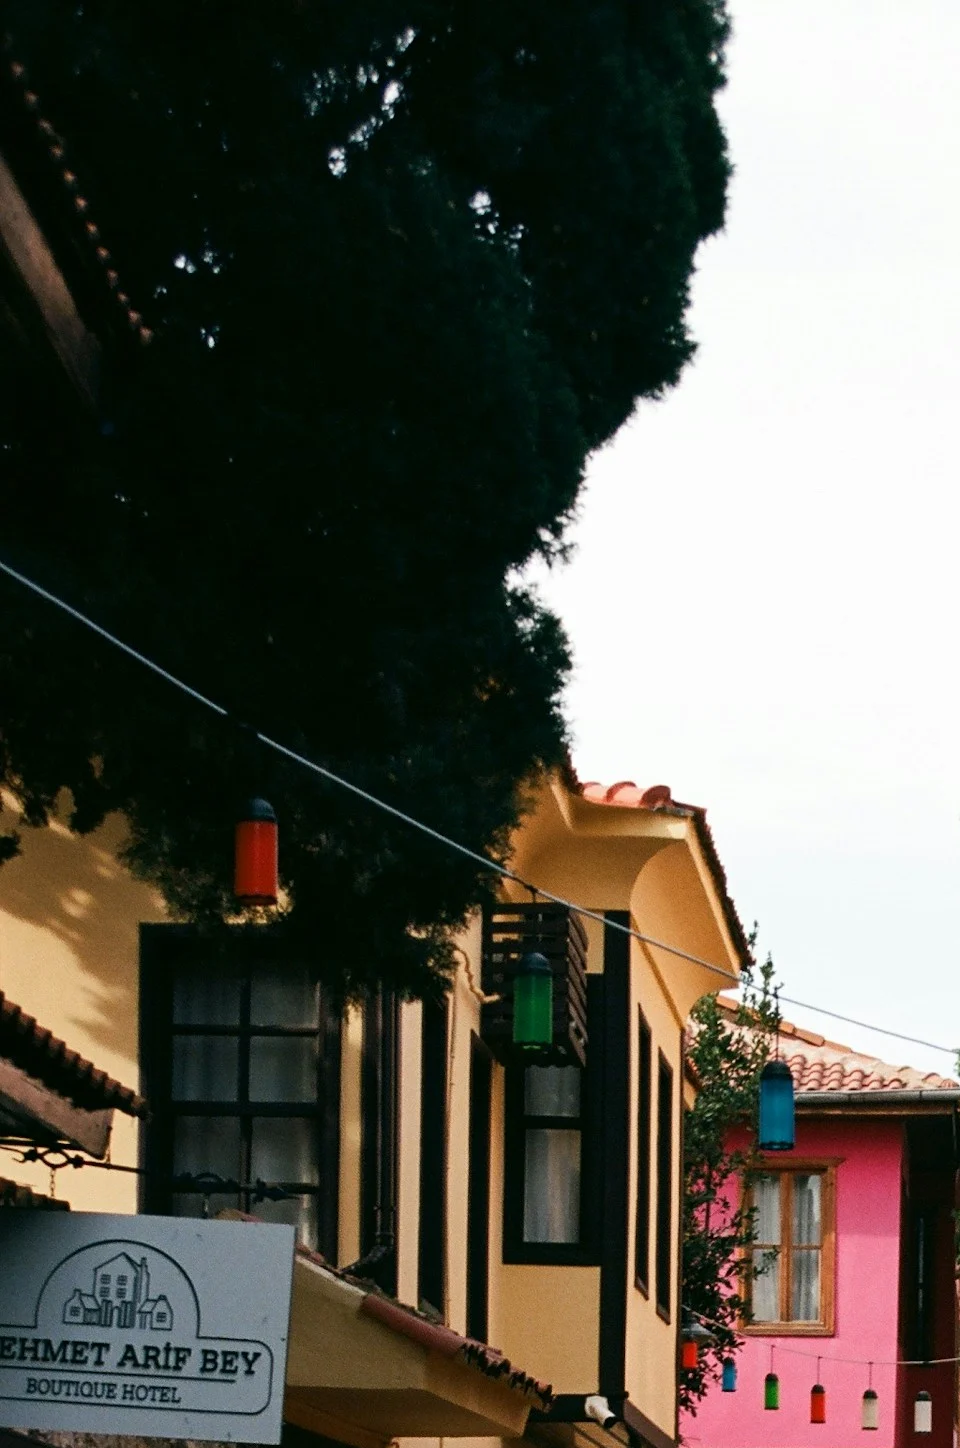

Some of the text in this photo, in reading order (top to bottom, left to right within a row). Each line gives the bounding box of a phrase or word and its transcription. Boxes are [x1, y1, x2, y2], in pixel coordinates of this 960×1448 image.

[0, 1335, 262, 1376] EHMET ARİF BEY
[26, 1378, 181, 1404] BOUTIQUE HOTEL
